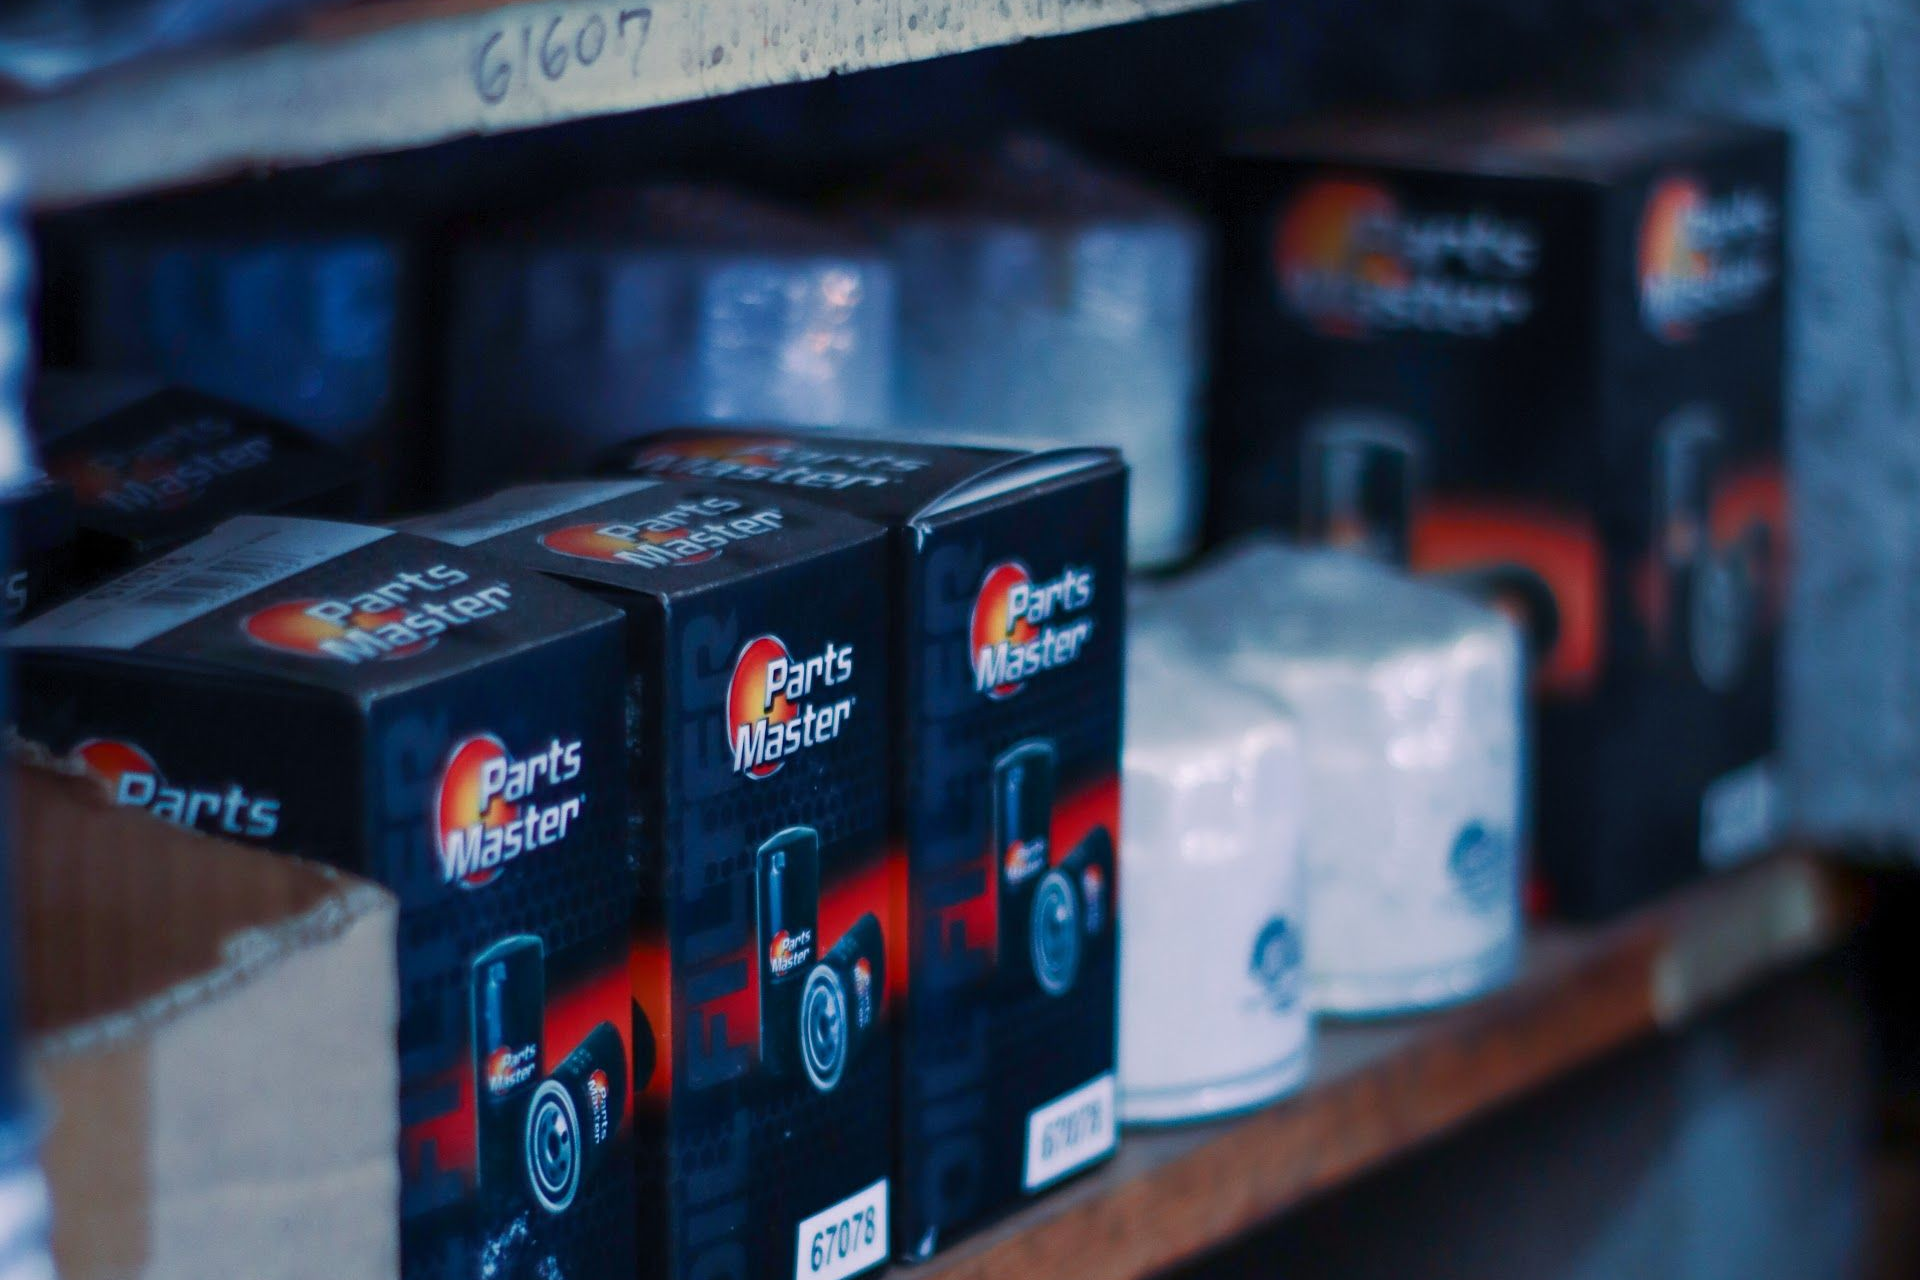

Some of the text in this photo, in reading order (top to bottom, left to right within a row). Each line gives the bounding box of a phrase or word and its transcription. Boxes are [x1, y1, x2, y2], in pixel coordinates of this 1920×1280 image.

[470, 8, 652, 104] 61607
[596, 496, 742, 542] Parts
[613, 510, 784, 569] Master
[304, 562, 469, 624] Parts
[317, 583, 510, 665] Master
[1006, 564, 1090, 634] Parts
[763, 642, 854, 708] Parts
[974, 618, 1088, 692] Master
[733, 697, 852, 775] Master
[114, 770, 282, 838] Parts
[478, 736, 583, 810] Parts
[443, 797, 581, 885] Master
[770, 948, 810, 975] Master
[781, 929, 811, 953] Parts
[810, 1204, 877, 1273] 67078
